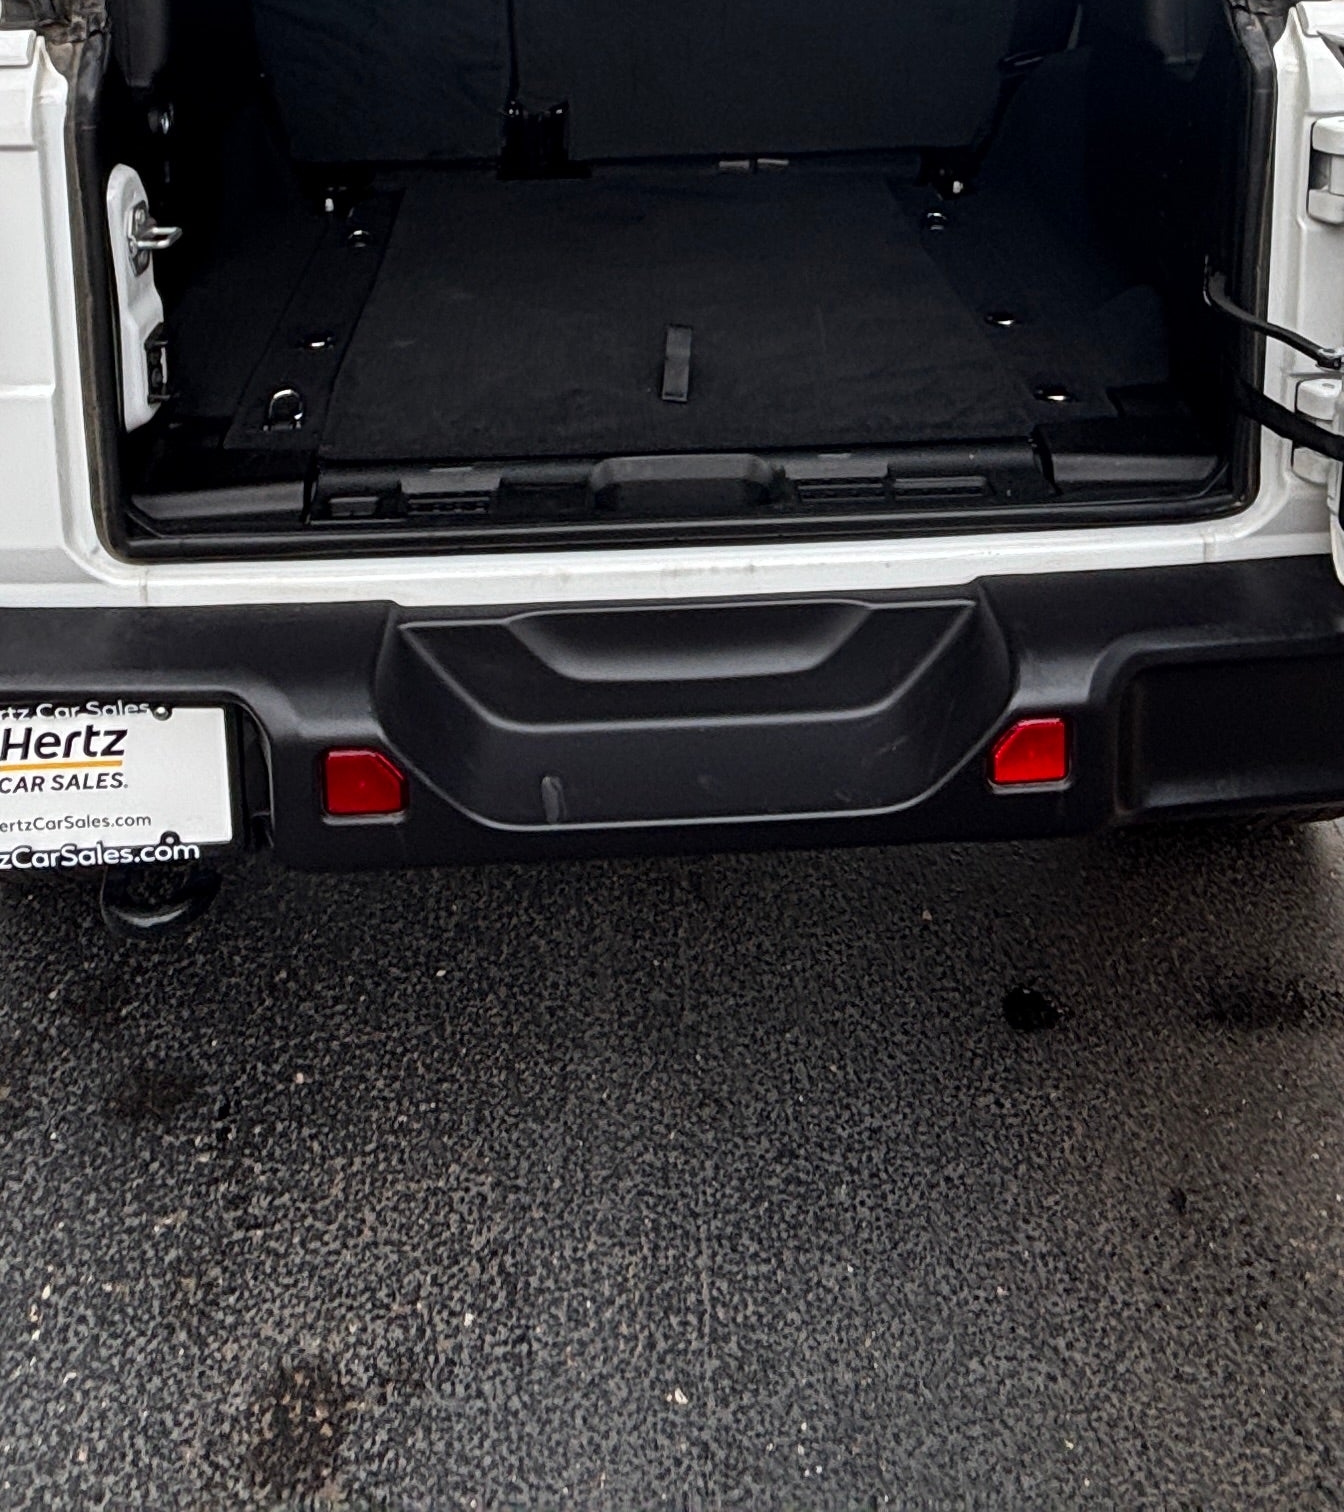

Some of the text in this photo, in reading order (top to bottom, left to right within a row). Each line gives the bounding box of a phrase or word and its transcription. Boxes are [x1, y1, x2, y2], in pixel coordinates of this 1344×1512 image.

[36, 702, 80, 719] Car
[86, 699, 150, 717] Sales
[0, 724, 128, 761] Hertz
